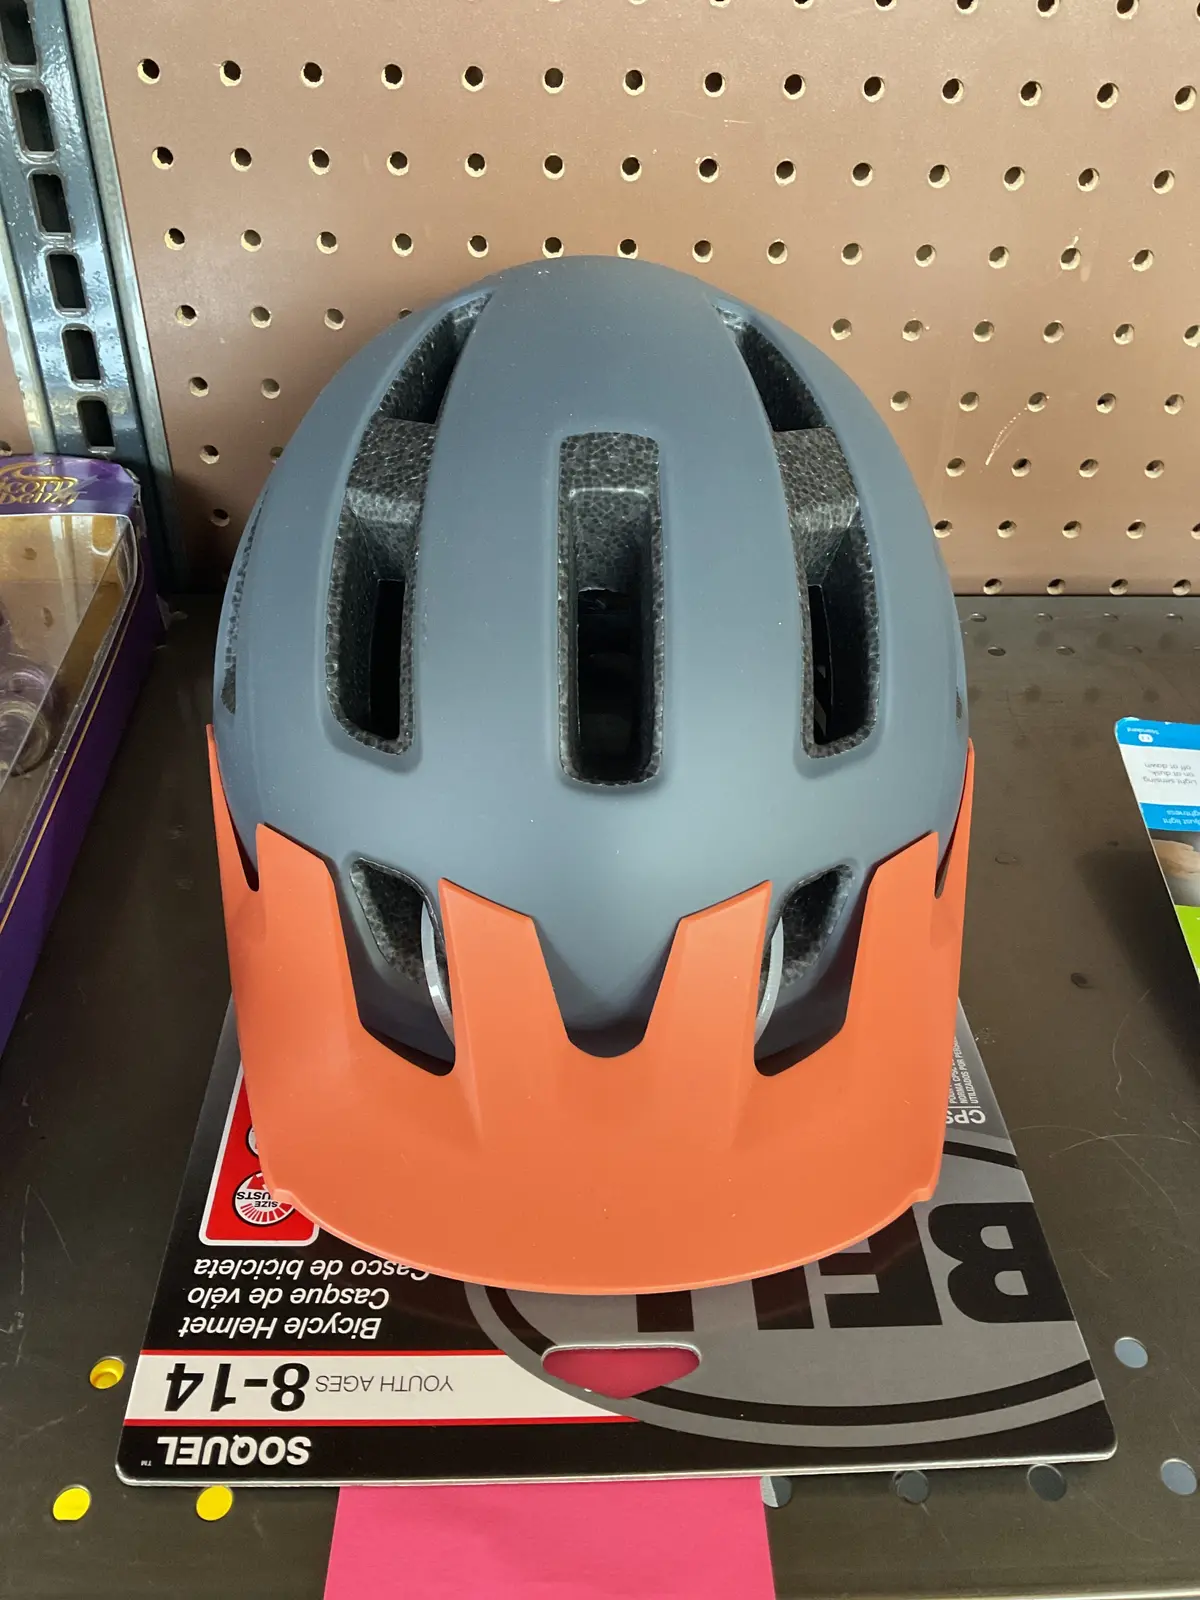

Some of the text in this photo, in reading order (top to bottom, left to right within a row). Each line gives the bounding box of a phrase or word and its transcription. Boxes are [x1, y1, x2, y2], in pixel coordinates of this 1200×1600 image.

[957, 1059, 967, 1071] POR
[954, 1082, 968, 1104] NORMA
[961, 1071, 979, 1104] UTILIZADOS
[237, 1192, 271, 1200] USTS
[194, 1259, 304, 1281] bicicleta
[310, 1258, 344, 1281] de
[187, 1283, 390, 1311] Casque de vélo
[178, 1312, 382, 1340] Bicycle Helmet
[165, 1362, 454, 1413] YOUTH AGES 8-14
[157, 1435, 312, 1466] SOQUEL
